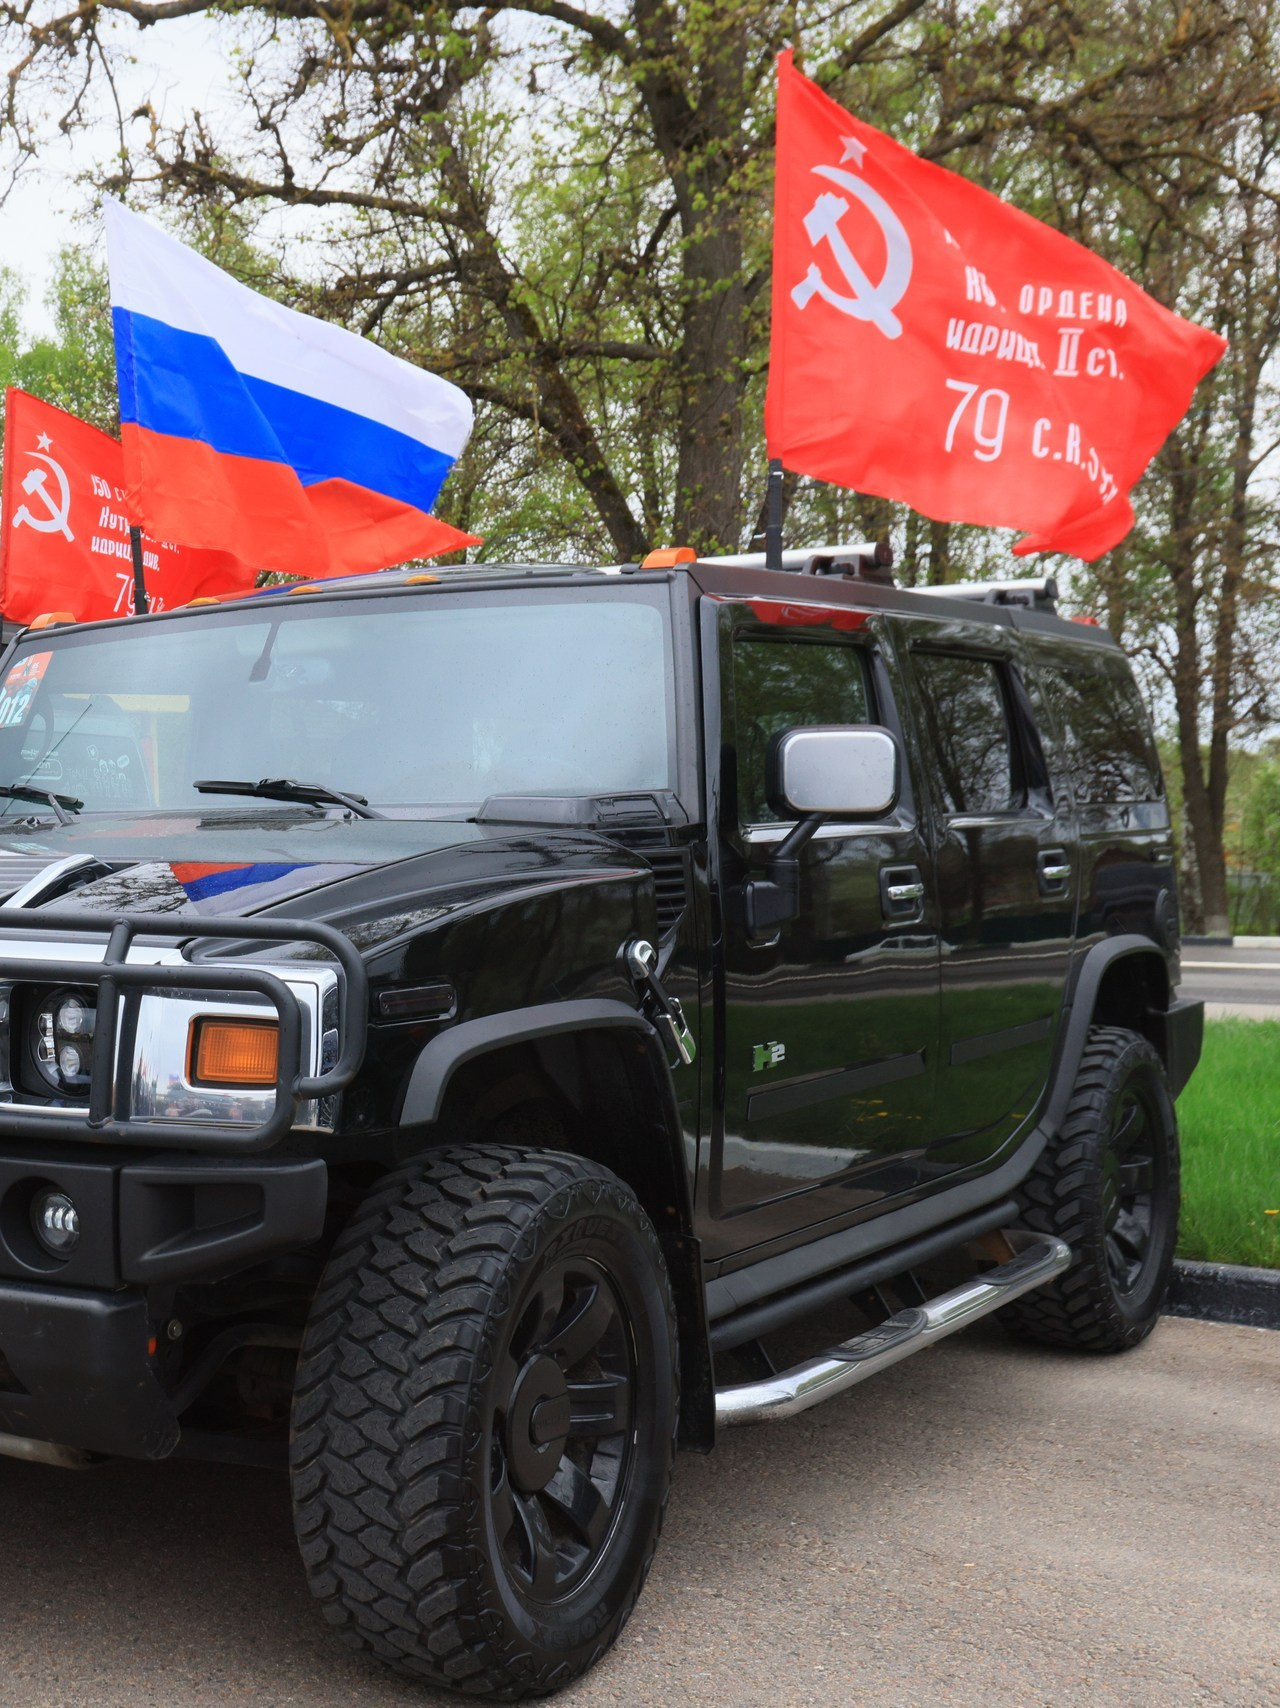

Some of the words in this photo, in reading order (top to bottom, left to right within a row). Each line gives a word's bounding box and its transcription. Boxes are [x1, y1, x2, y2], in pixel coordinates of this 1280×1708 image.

[945, 378, 1010, 462] 79
[90, 474, 111, 499] 150
[753, 1041, 785, 1073] H2
